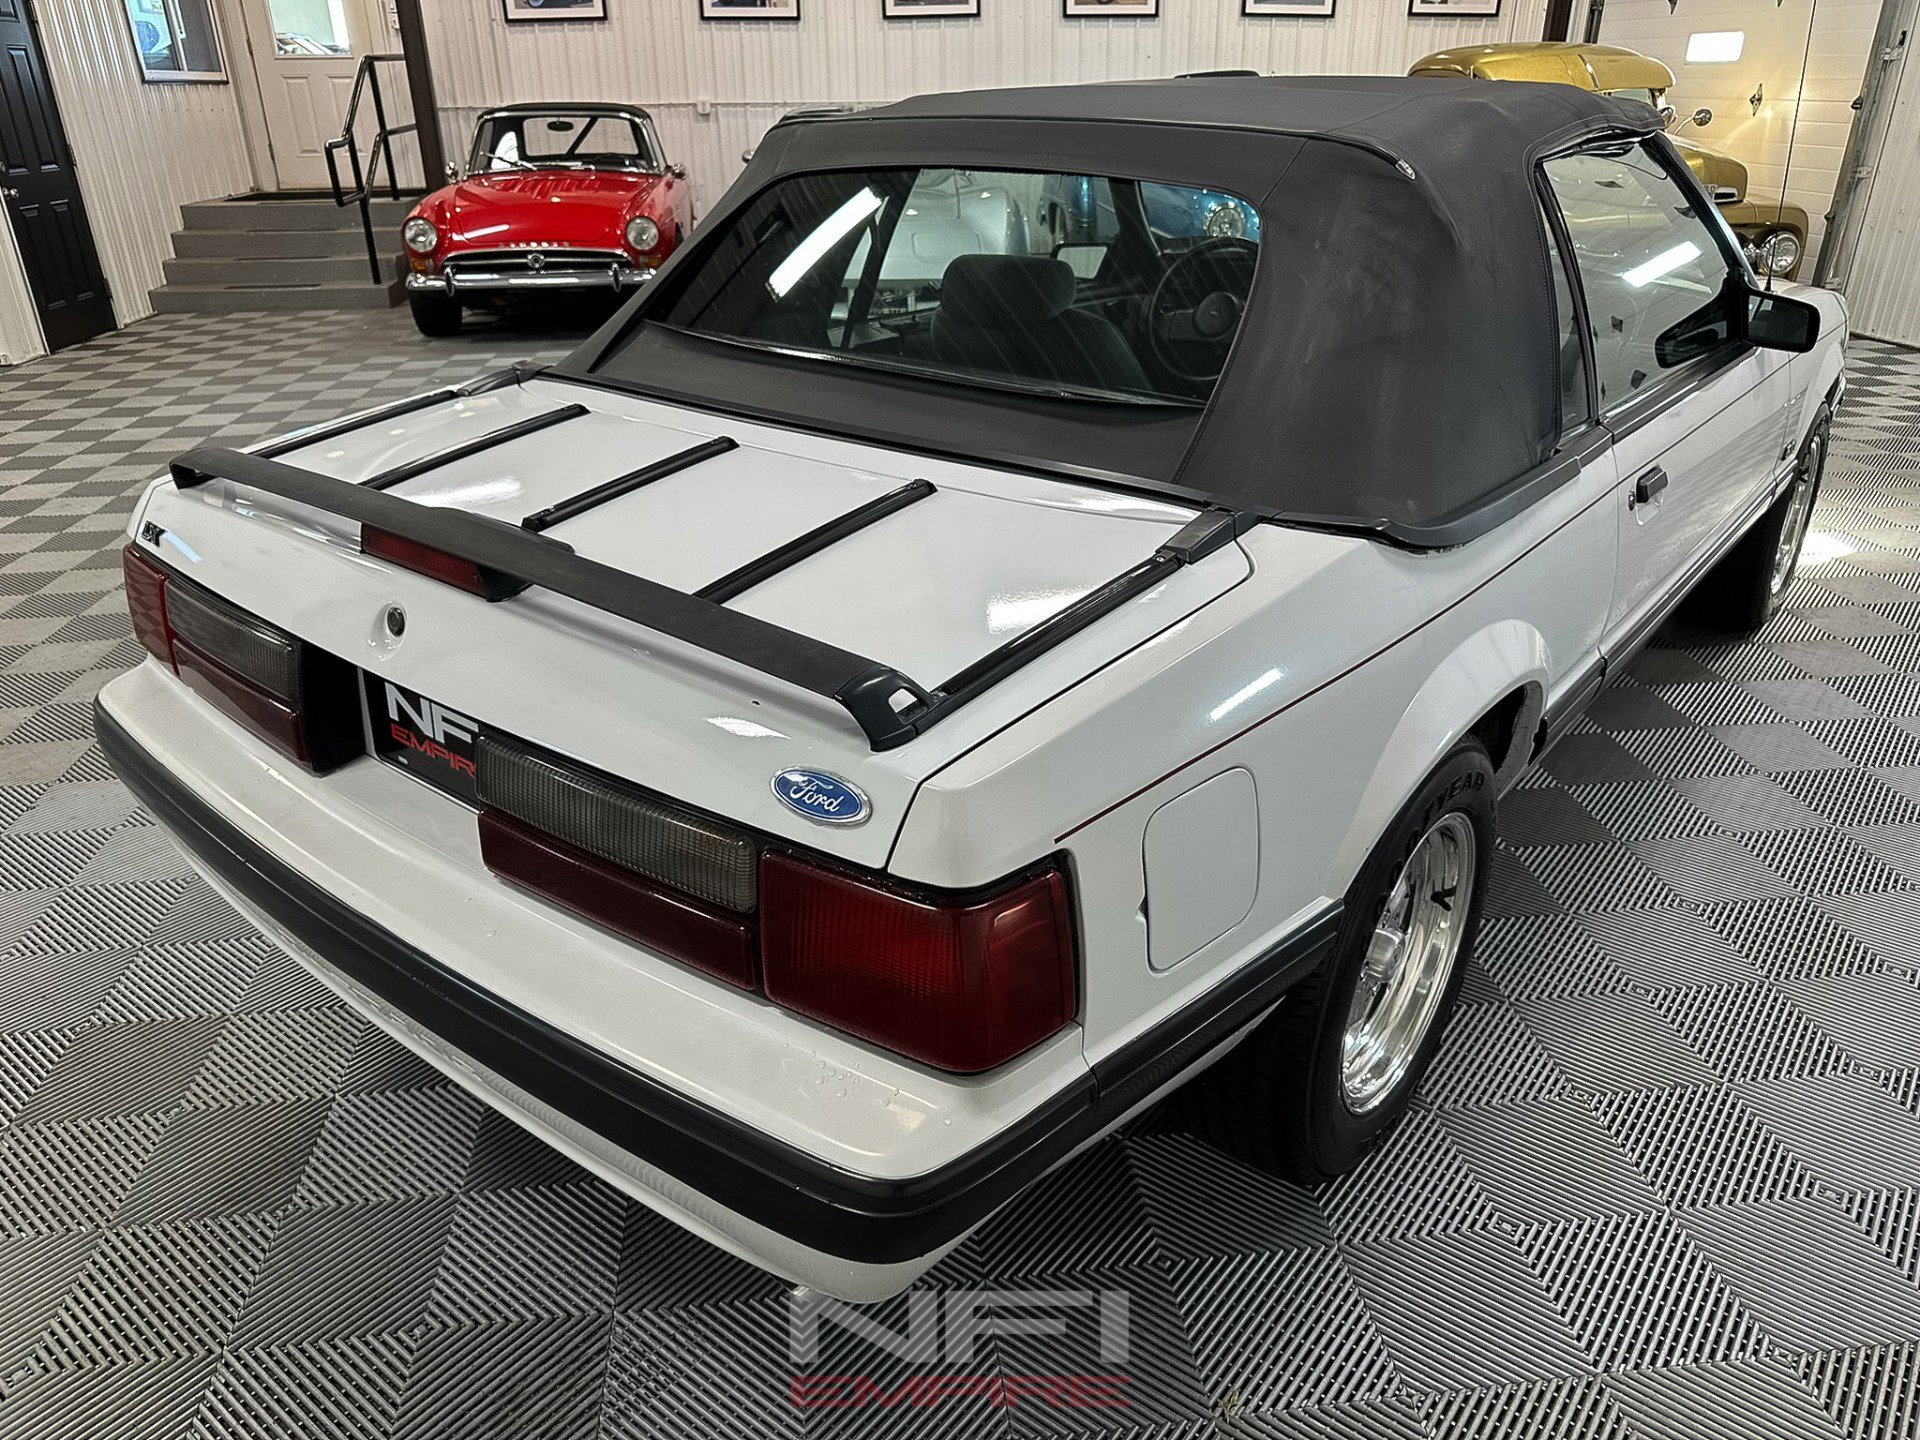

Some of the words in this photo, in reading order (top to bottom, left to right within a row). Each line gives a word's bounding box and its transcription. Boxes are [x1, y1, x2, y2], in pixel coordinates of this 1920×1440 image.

[384, 681, 479, 744] NF
[391, 723, 476, 778] EMPIR
[785, 773, 845, 812] Ford
